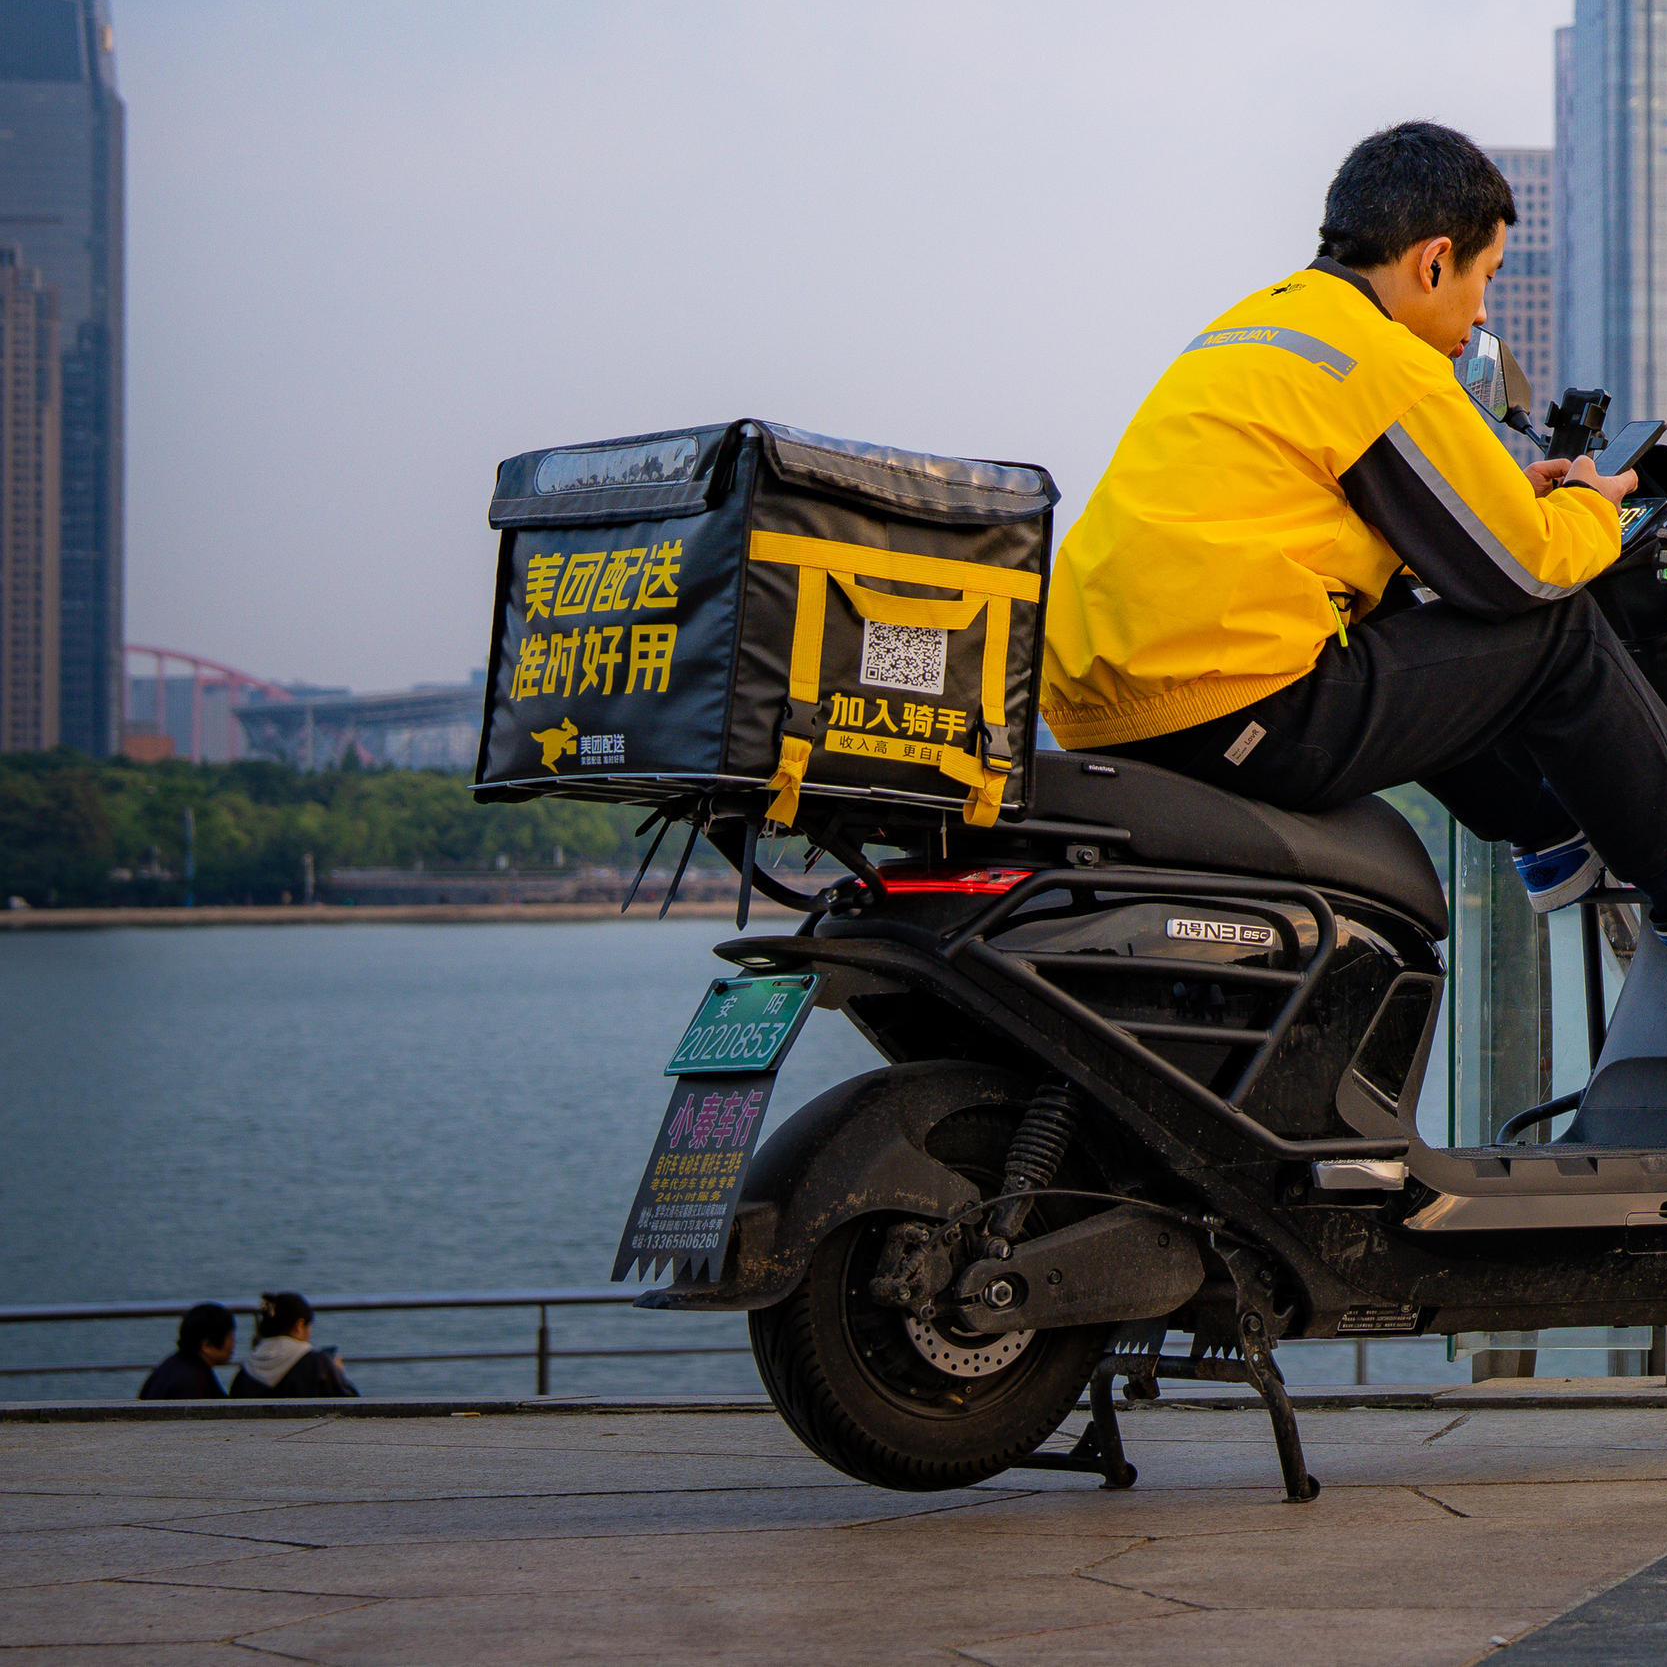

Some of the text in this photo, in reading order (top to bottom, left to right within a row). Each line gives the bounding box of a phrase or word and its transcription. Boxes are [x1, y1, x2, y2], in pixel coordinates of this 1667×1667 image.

[1202, 329, 1279, 346] MEITUAN
[525, 540, 682, 623] 美团配送
[509, 623, 677, 702] 准时好用
[828, 692, 968, 742] 加入骑手
[580, 733, 625, 755] 美团配送
[839, 734, 889, 755] 收入高
[673, 1022, 786, 1063] 2020853
[655, 1190, 722, 1203] 24小时服务
